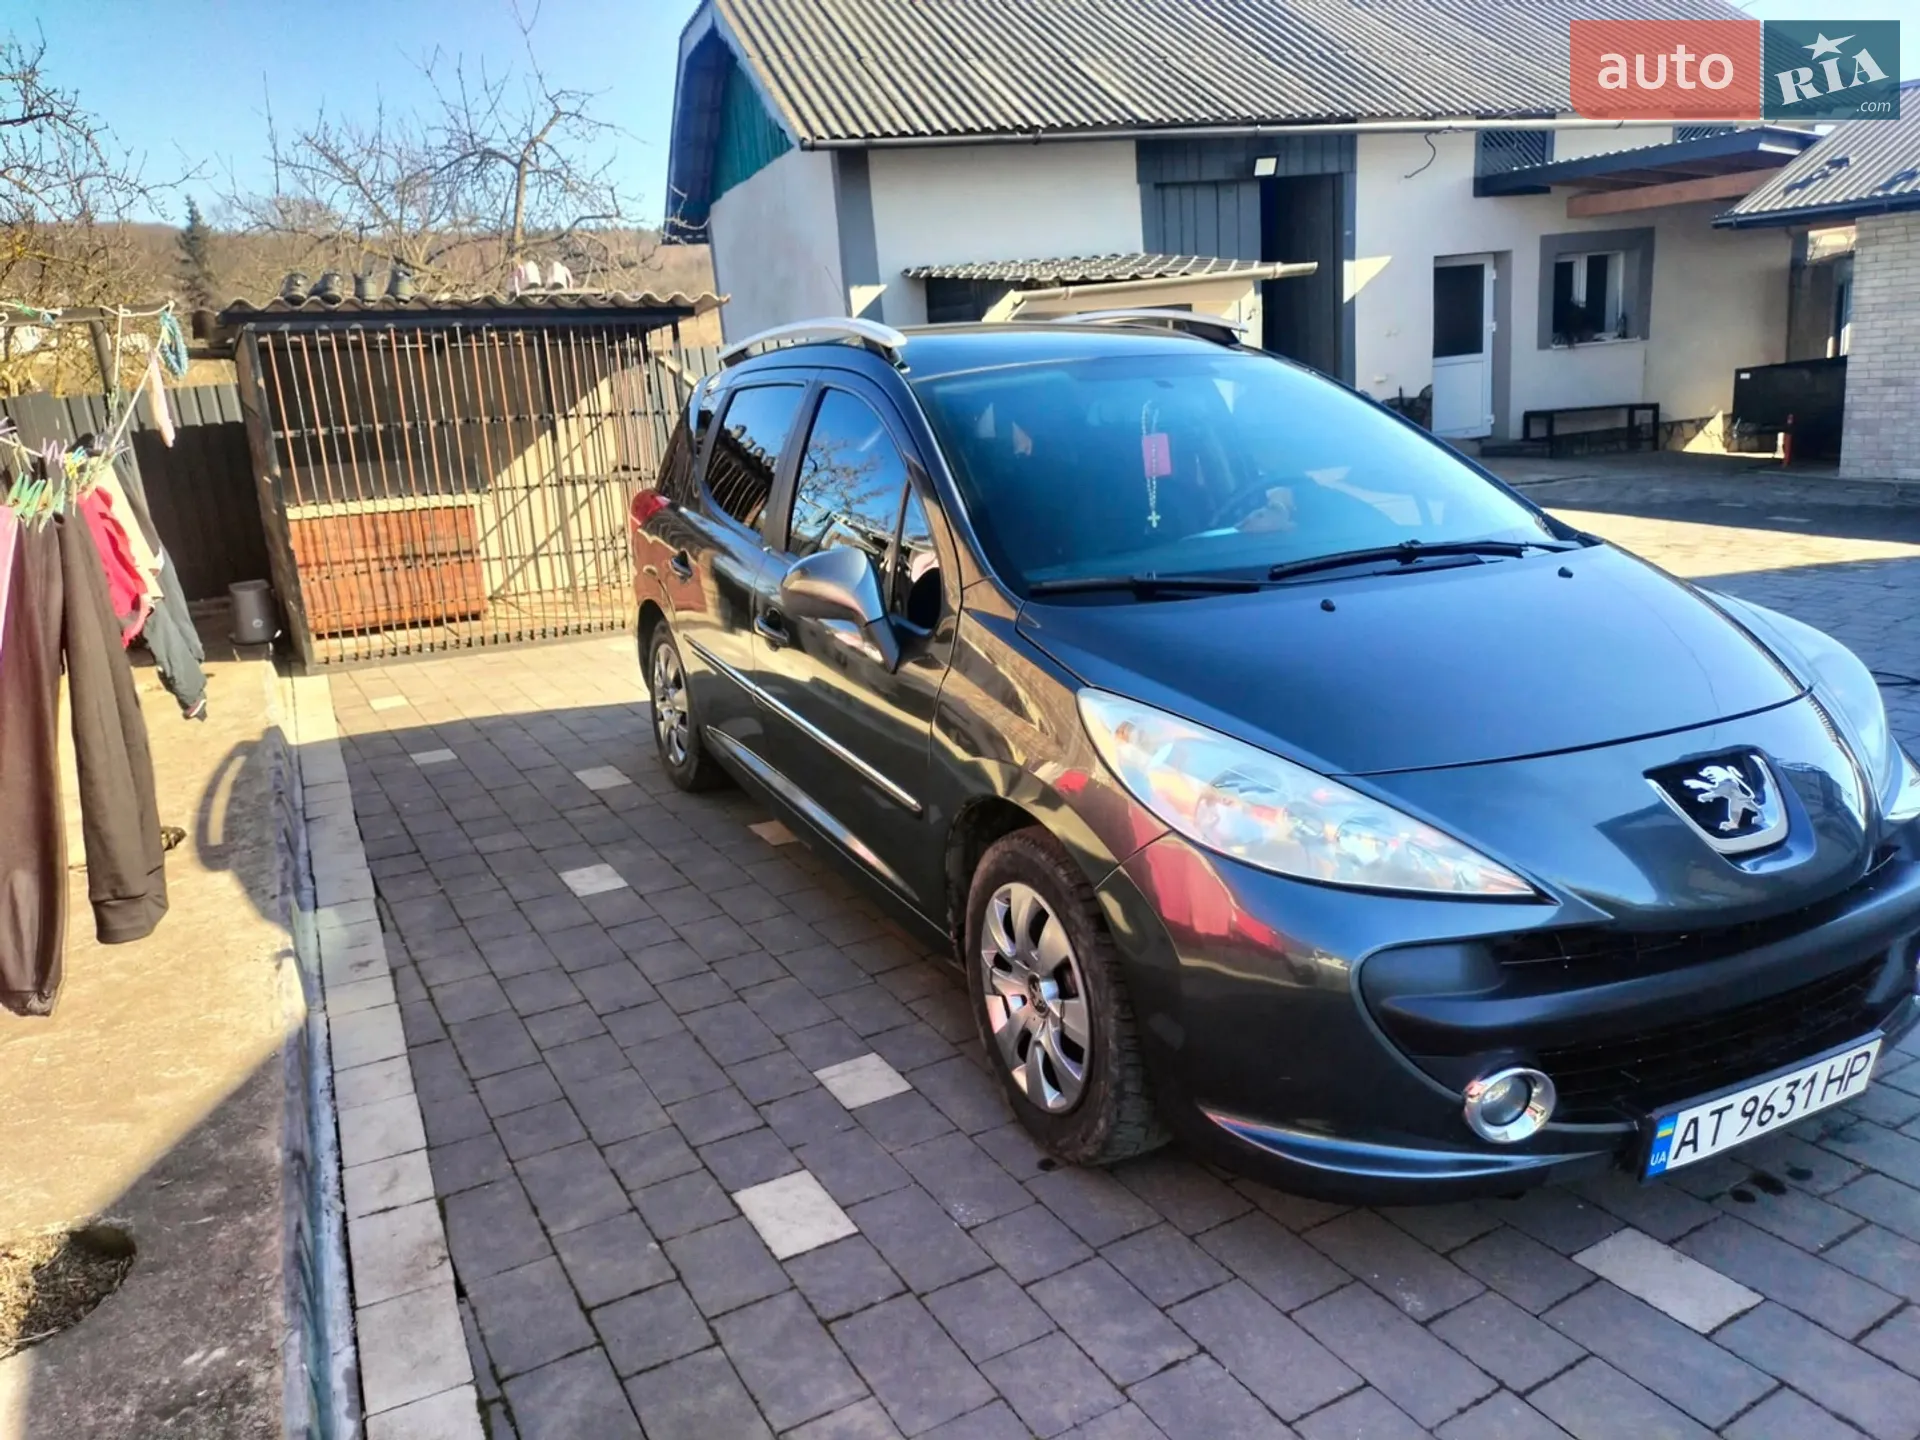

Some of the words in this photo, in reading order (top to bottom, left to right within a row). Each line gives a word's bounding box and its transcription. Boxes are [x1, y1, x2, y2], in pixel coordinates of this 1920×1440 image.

[1672, 1103, 1734, 1160] AT
[1736, 1071, 1819, 1137] 9631
[1820, 1051, 1871, 1101] HP
[1650, 1152, 1667, 1166] UA
